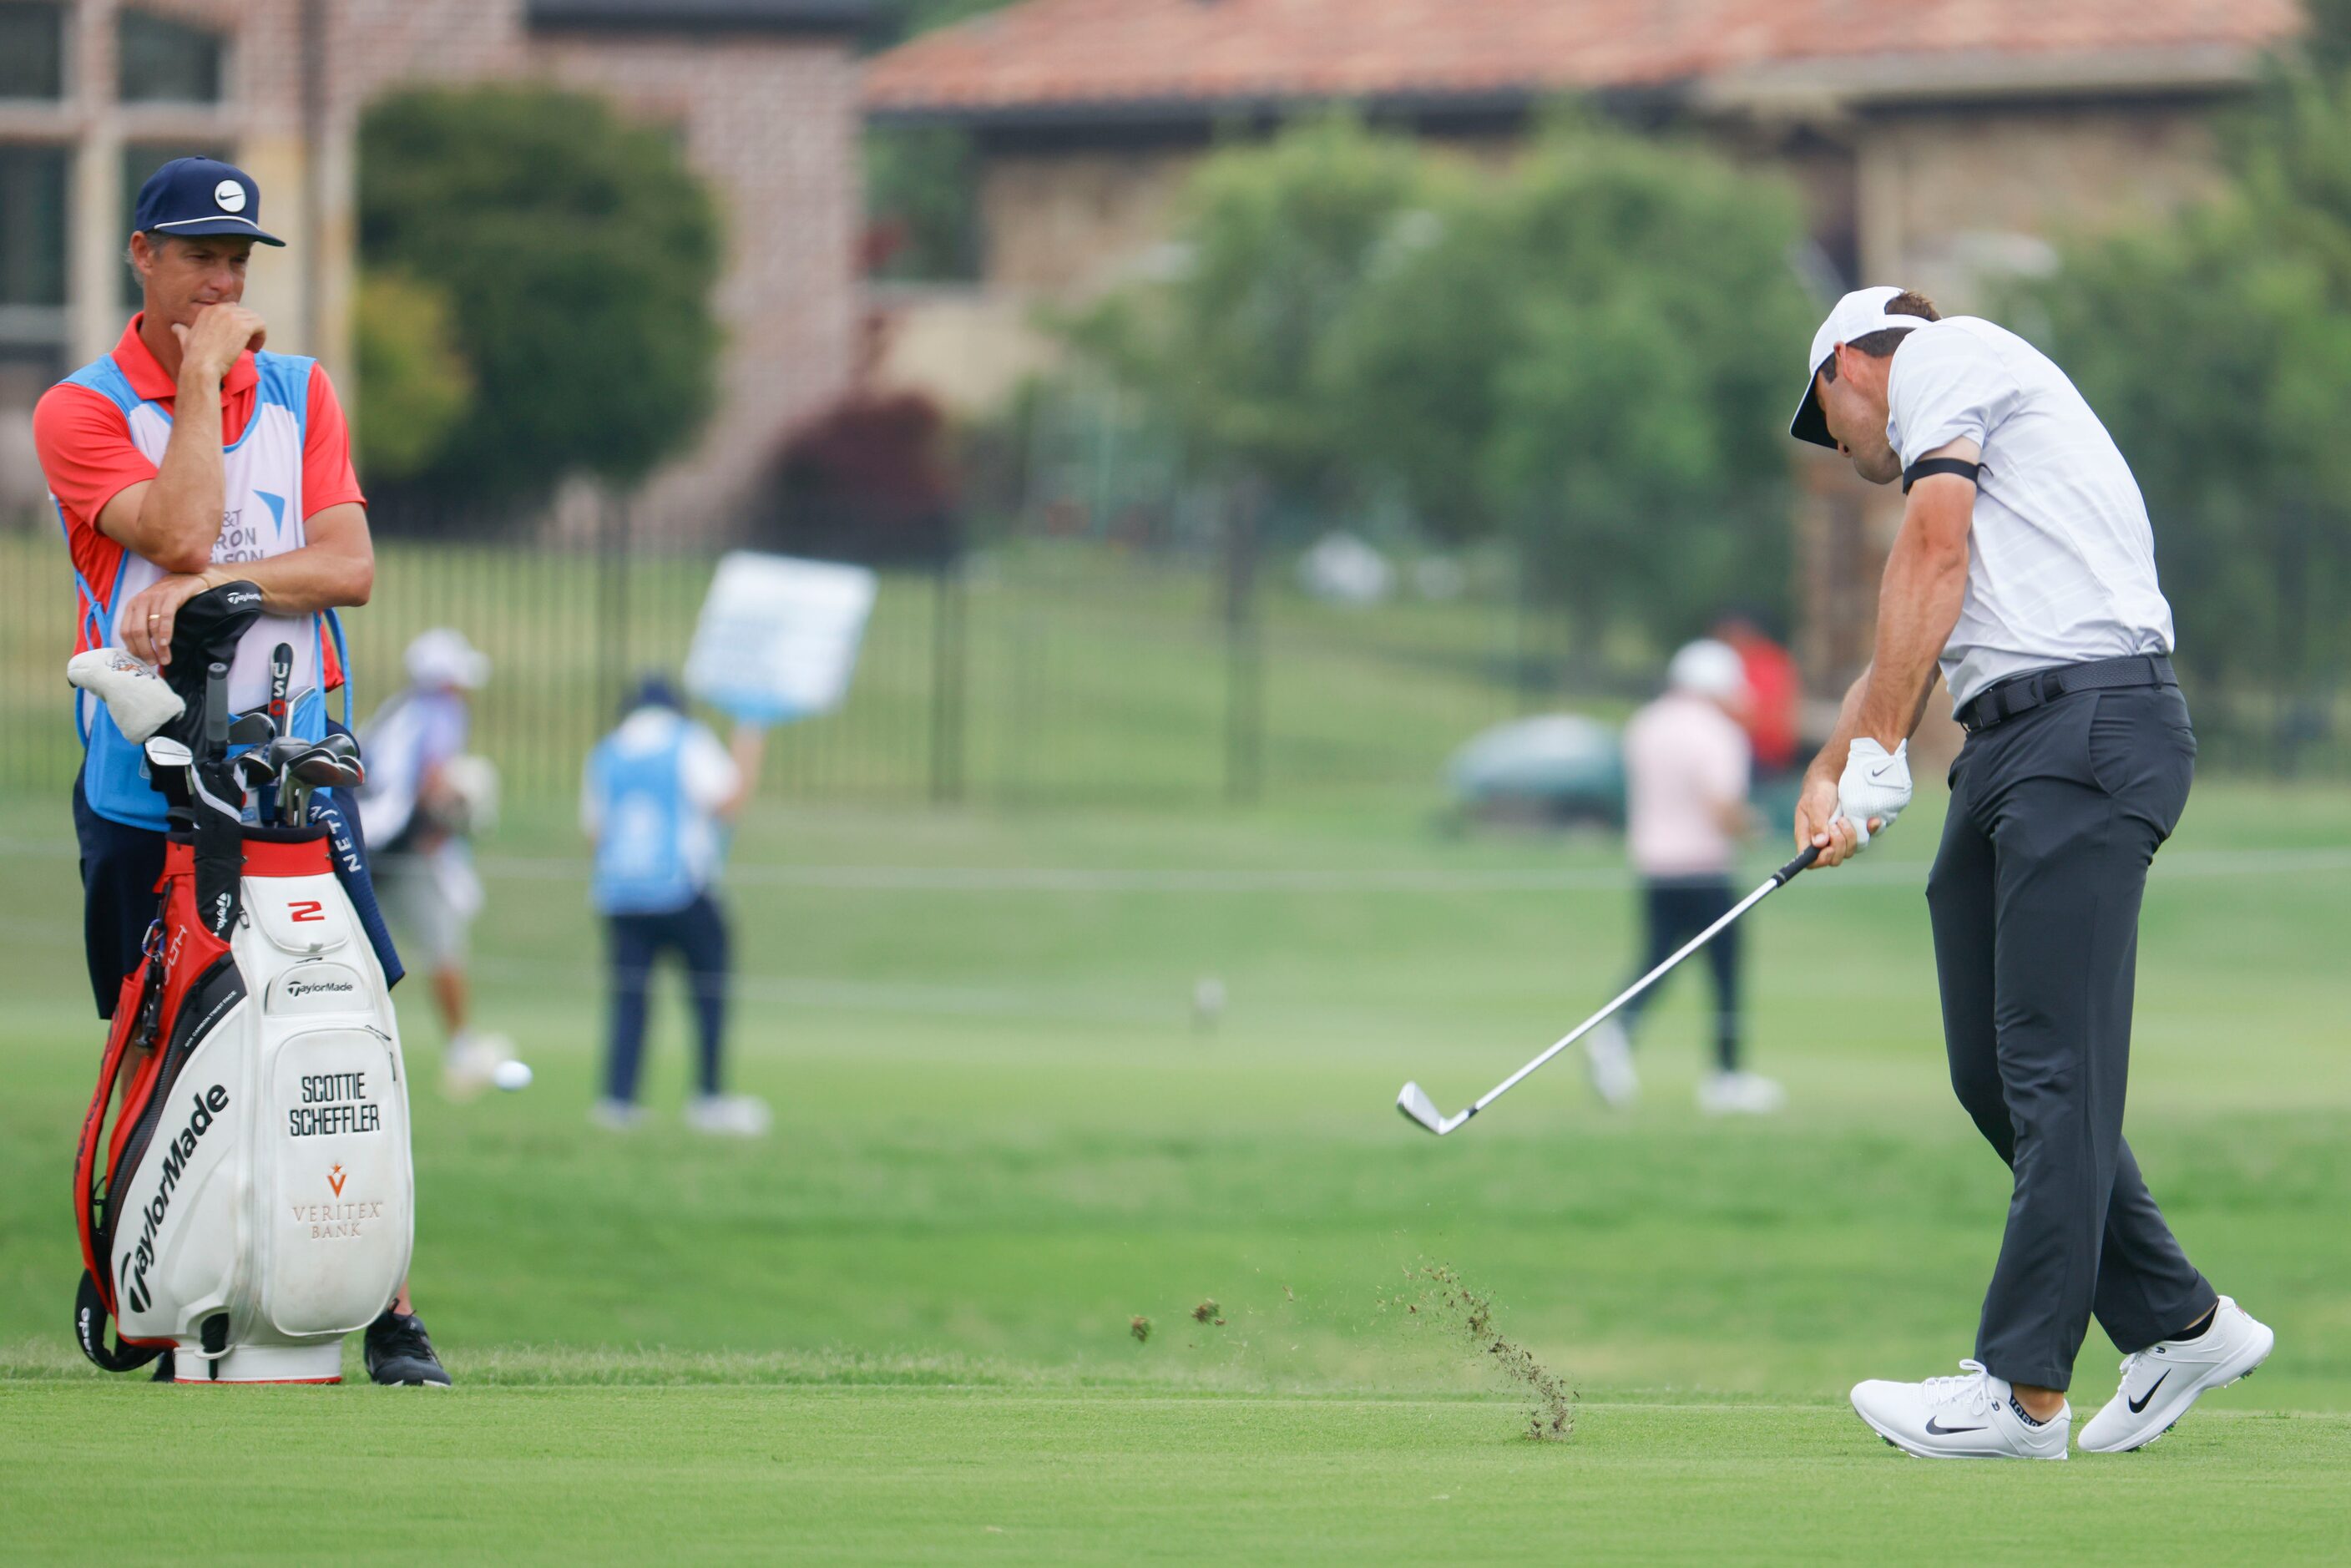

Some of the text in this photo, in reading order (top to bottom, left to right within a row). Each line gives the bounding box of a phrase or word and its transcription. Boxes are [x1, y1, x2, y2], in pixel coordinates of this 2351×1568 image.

[215, 527, 256, 549] RON
[287, 901, 325, 923] 2
[287, 980, 353, 997] TaylorMade
[301, 1072, 366, 1103] SCOTTIE
[289, 1104, 380, 1136] SCHEFFLER
[120, 1084, 230, 1313] TaylorMade
[292, 1202, 382, 1222] VERITEX
[311, 1222, 361, 1239] BANK
